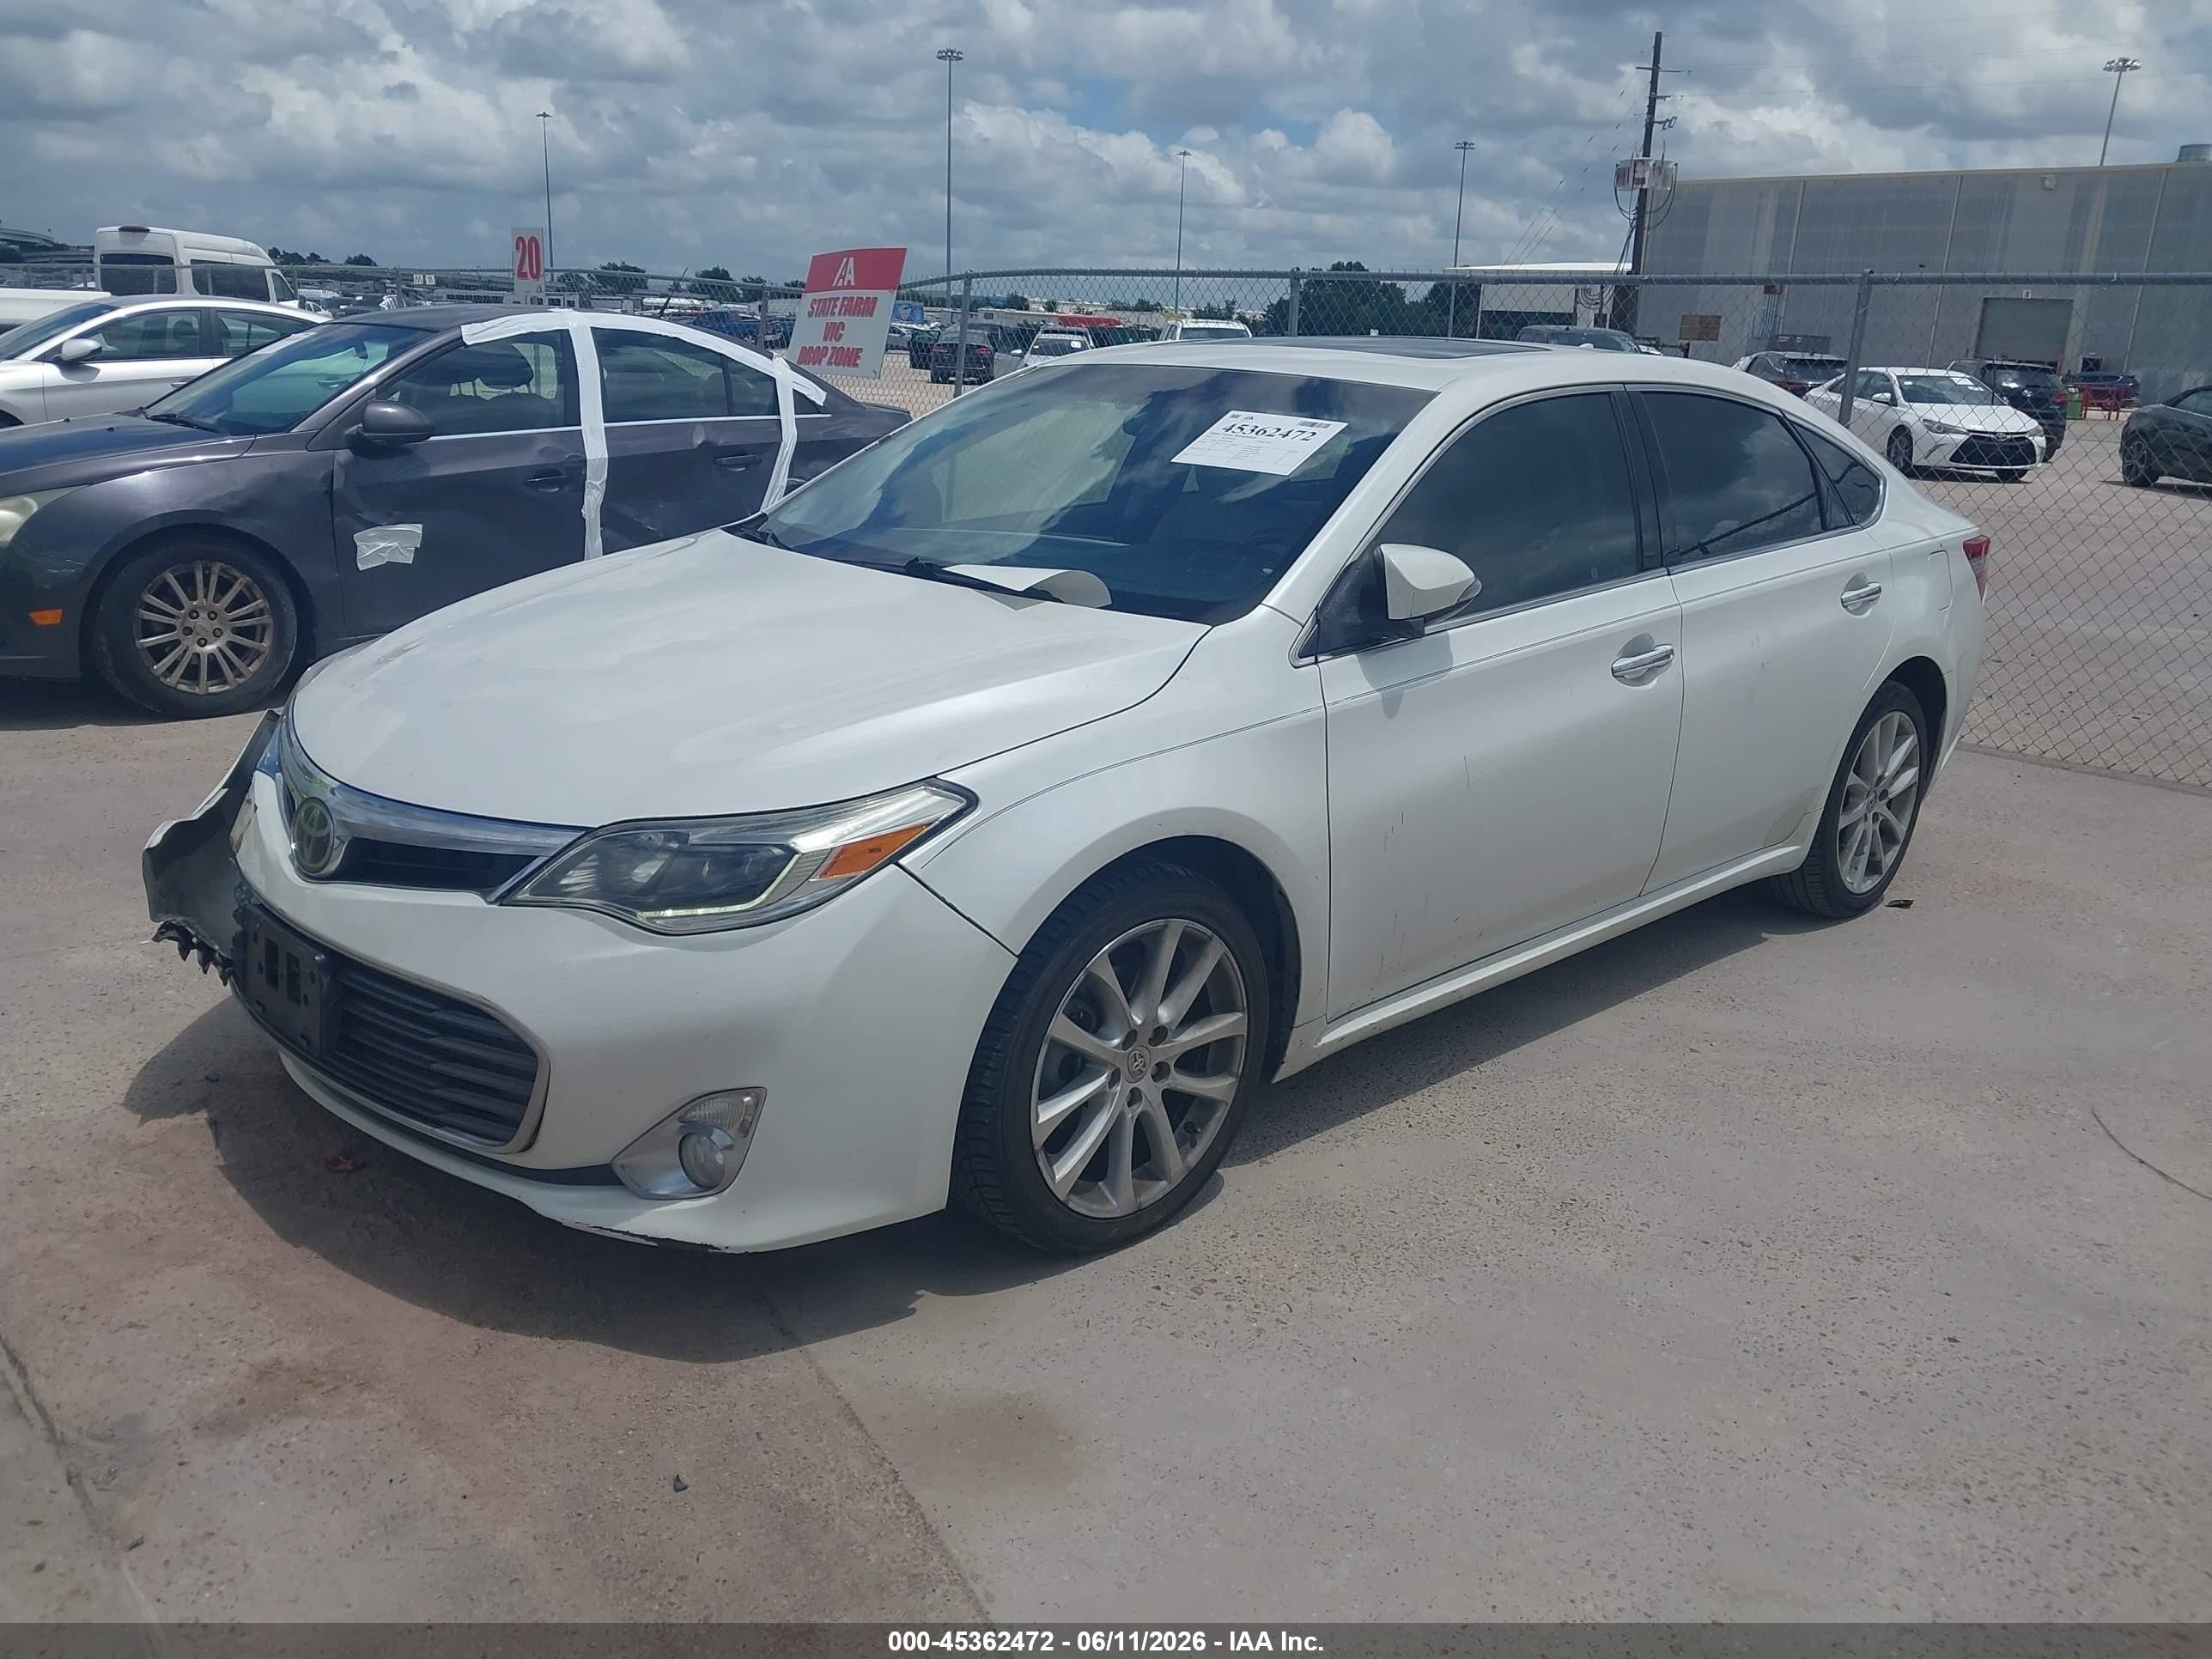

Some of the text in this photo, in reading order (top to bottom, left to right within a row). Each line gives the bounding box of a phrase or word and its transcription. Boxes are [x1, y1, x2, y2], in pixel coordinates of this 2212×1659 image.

[515, 235, 541, 279] 20
[807, 296, 878, 318] STATE FARM
[797, 345, 863, 368] DROP ZONE
[1223, 423, 1317, 441] 45362472
